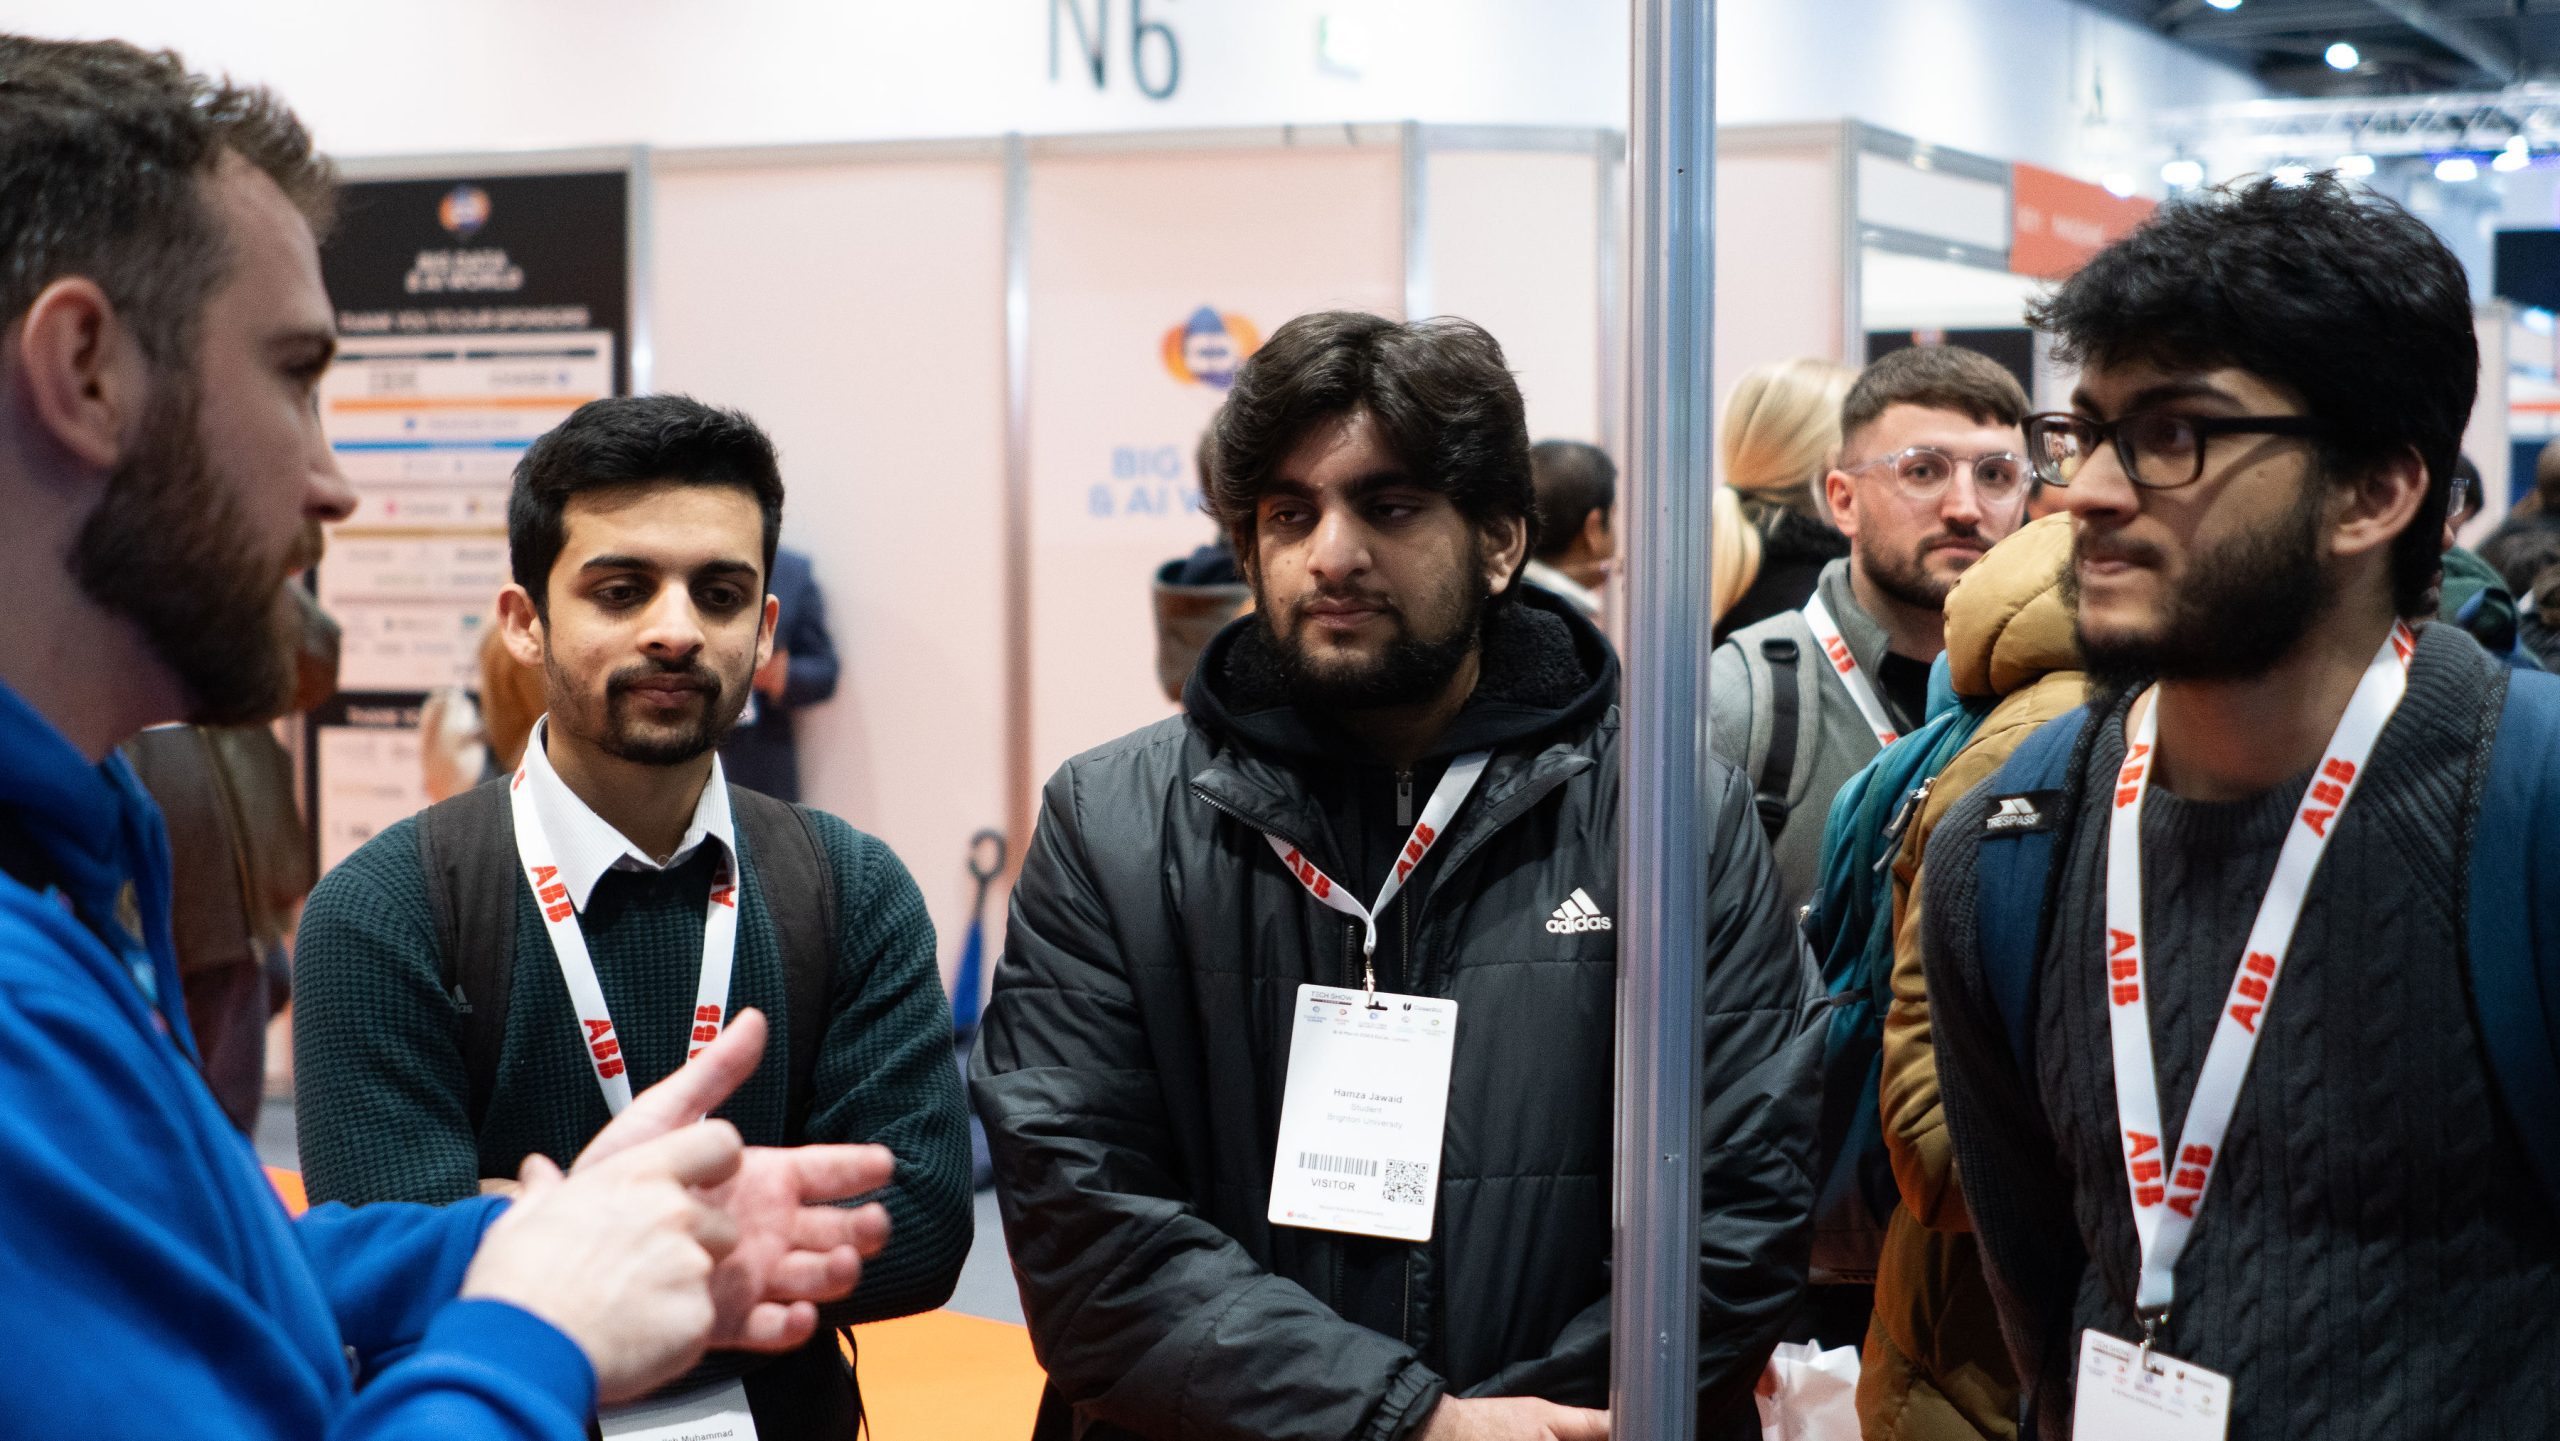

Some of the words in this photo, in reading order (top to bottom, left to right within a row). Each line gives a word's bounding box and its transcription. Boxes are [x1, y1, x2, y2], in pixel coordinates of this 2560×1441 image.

[1049, 0, 1181, 101] N6
[1112, 447, 1180, 479] BIG
[1126, 486, 1168, 515] AI
[2302, 757, 2356, 839] ABB
[1285, 848, 1331, 898] ABB
[1396, 823, 1435, 884] ABB
[531, 865, 573, 923] ABB
[1545, 913, 1612, 935] adidas
[2109, 928, 2139, 1006] ABB
[2229, 951, 2276, 1035] ABB
[583, 1019, 624, 1080] ABB
[1333, 1088, 1366, 1100] Hamza
[1369, 1092, 1403, 1104] Jawaid
[1311, 1178, 1356, 1191] VISITOR
[2126, 1130, 2165, 1207] ABB
[2167, 1144, 2213, 1218] ABB
